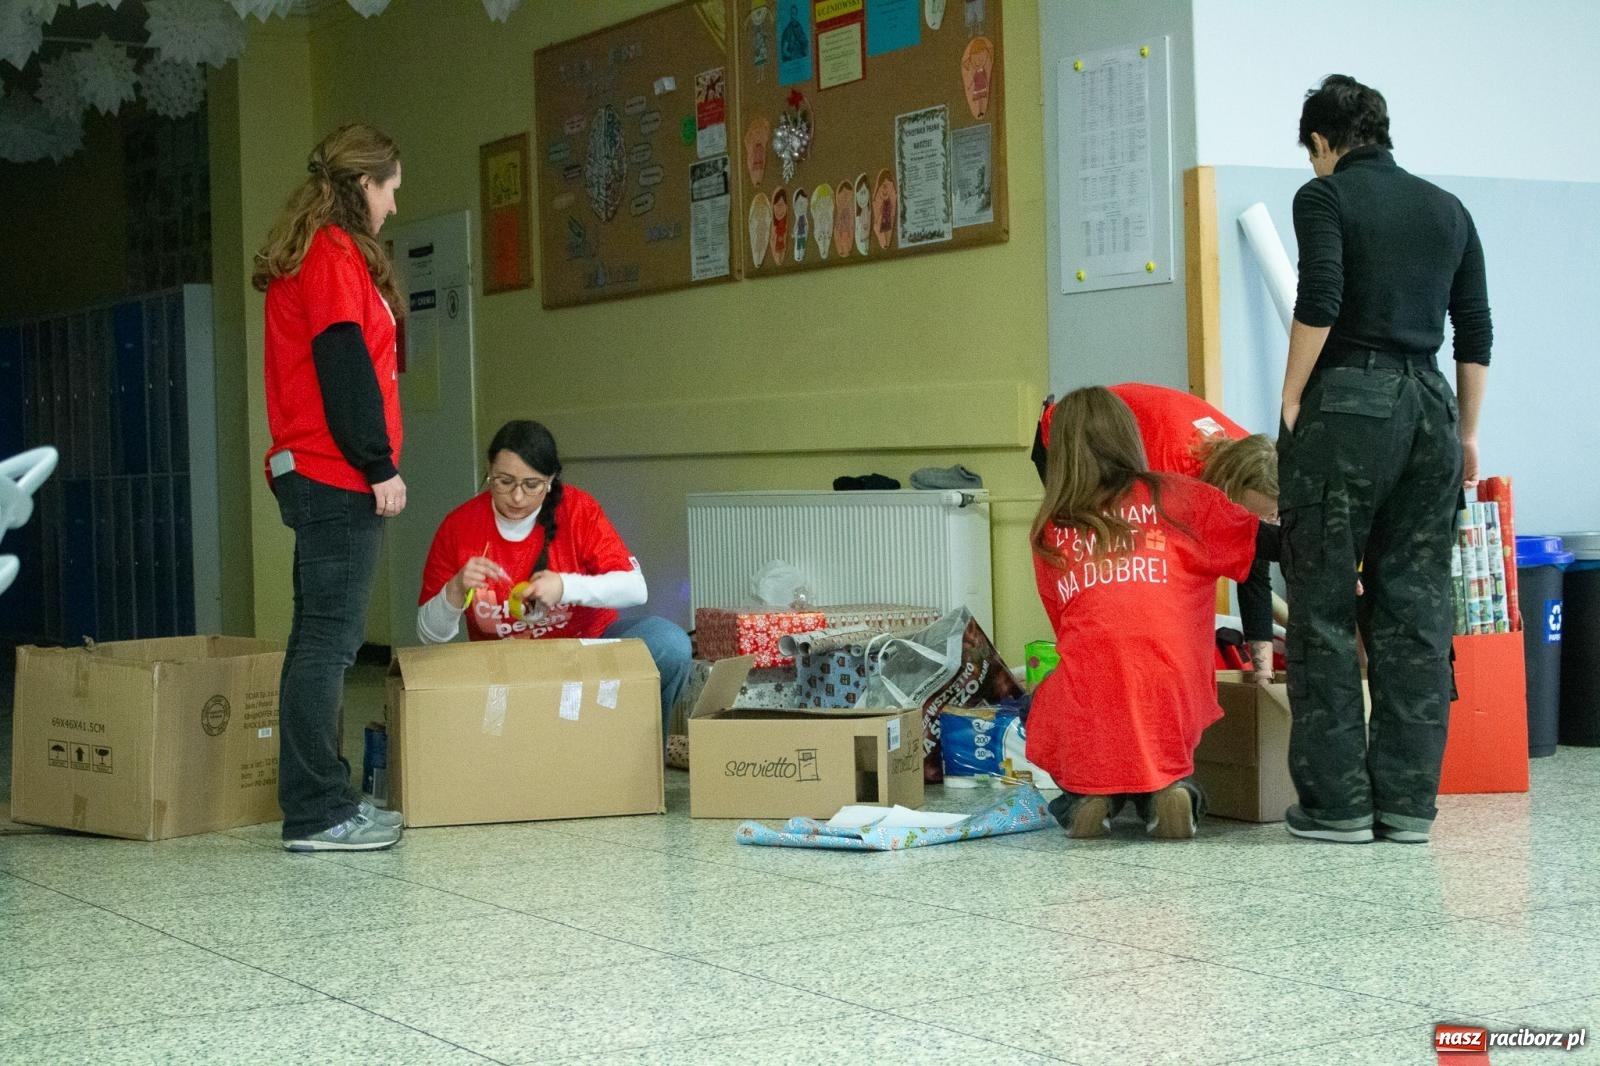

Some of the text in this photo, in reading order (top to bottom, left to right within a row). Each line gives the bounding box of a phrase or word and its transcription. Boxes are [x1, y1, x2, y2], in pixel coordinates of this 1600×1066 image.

[1057, 556, 1168, 604] NA DOBRE!
[926, 662, 975, 717] WSZYSTKO
[51, 716, 105, 734] 69X46X41.5CM
[975, 736, 989, 744] 200
[724, 757, 797, 779] servietto
